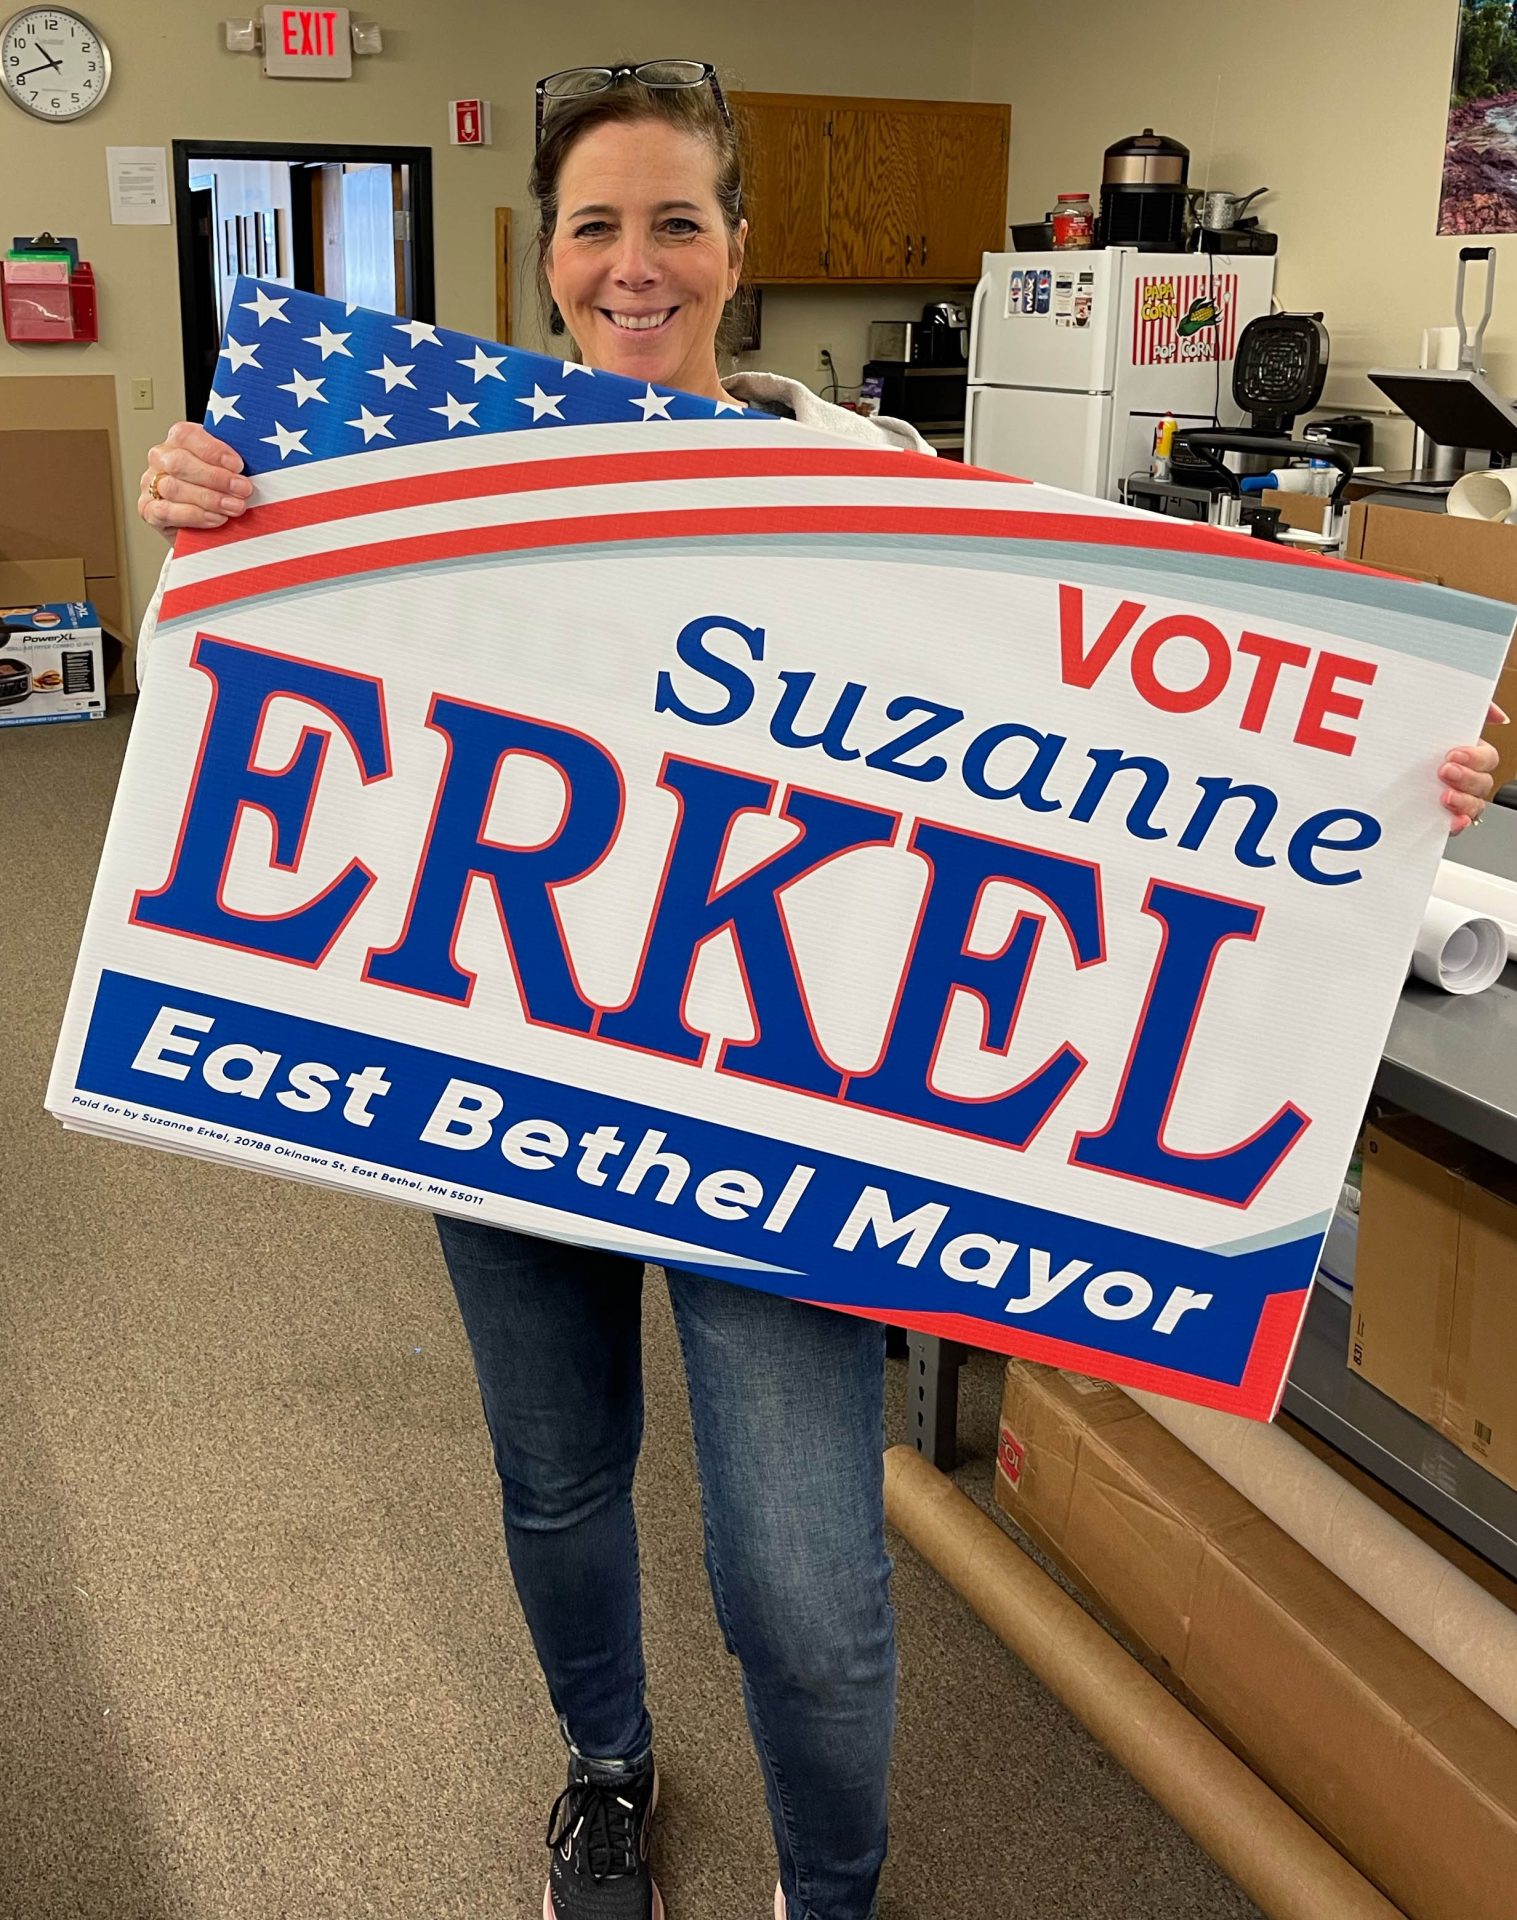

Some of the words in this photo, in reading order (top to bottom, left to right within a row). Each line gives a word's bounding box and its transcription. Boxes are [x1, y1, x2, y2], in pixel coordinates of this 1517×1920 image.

[27, 24, 35, 34] 11
[44, 19, 59, 30] 12
[70, 27, 74, 38] 1
[282, 10, 337, 56] EXIT
[14, 37, 26, 49] 10
[81, 42, 91, 53] 2
[10, 56, 20, 66] 9
[87, 61, 96, 72] 3
[16, 74, 26, 86] 8
[83, 79, 92, 89] 4
[30, 90, 39, 101] 7
[71, 92, 80, 103] 5
[51, 98, 60, 108] 6
[1144, 282, 1175, 302] PAPA
[1141, 302, 1177, 322] CORN
[1153, 342, 1177, 360] POP
[1181, 340, 1215, 359] CORN
[23, 633, 76, 644] PowerXL
[1058, 583, 1378, 757] VOTE
[654, 615, 1382, 886] Suzanne
[128, 631, 1312, 1210] ERKEL
[72, 1096, 99, 1109] Paid
[102, 1103, 120, 1115] for
[123, 1108, 139, 1120] by
[142, 1113, 194, 1133] Suzanne
[197, 1126, 230, 1143] Erkel,
[234, 1136, 272, 1152] 20788
[274, 1146, 328, 1166] Okinawa
[331, 1160, 347, 1172] St,
[351, 1165, 379, 1179] East
[381, 1173, 423, 1192] Bethel,
[427, 1184, 447, 1196] MN
[450, 1190, 485, 1206] 55011
[130, 1006, 392, 1128] East
[418, 1078, 816, 1234] Bethel
[832, 1185, 1214, 1335] Mayor
